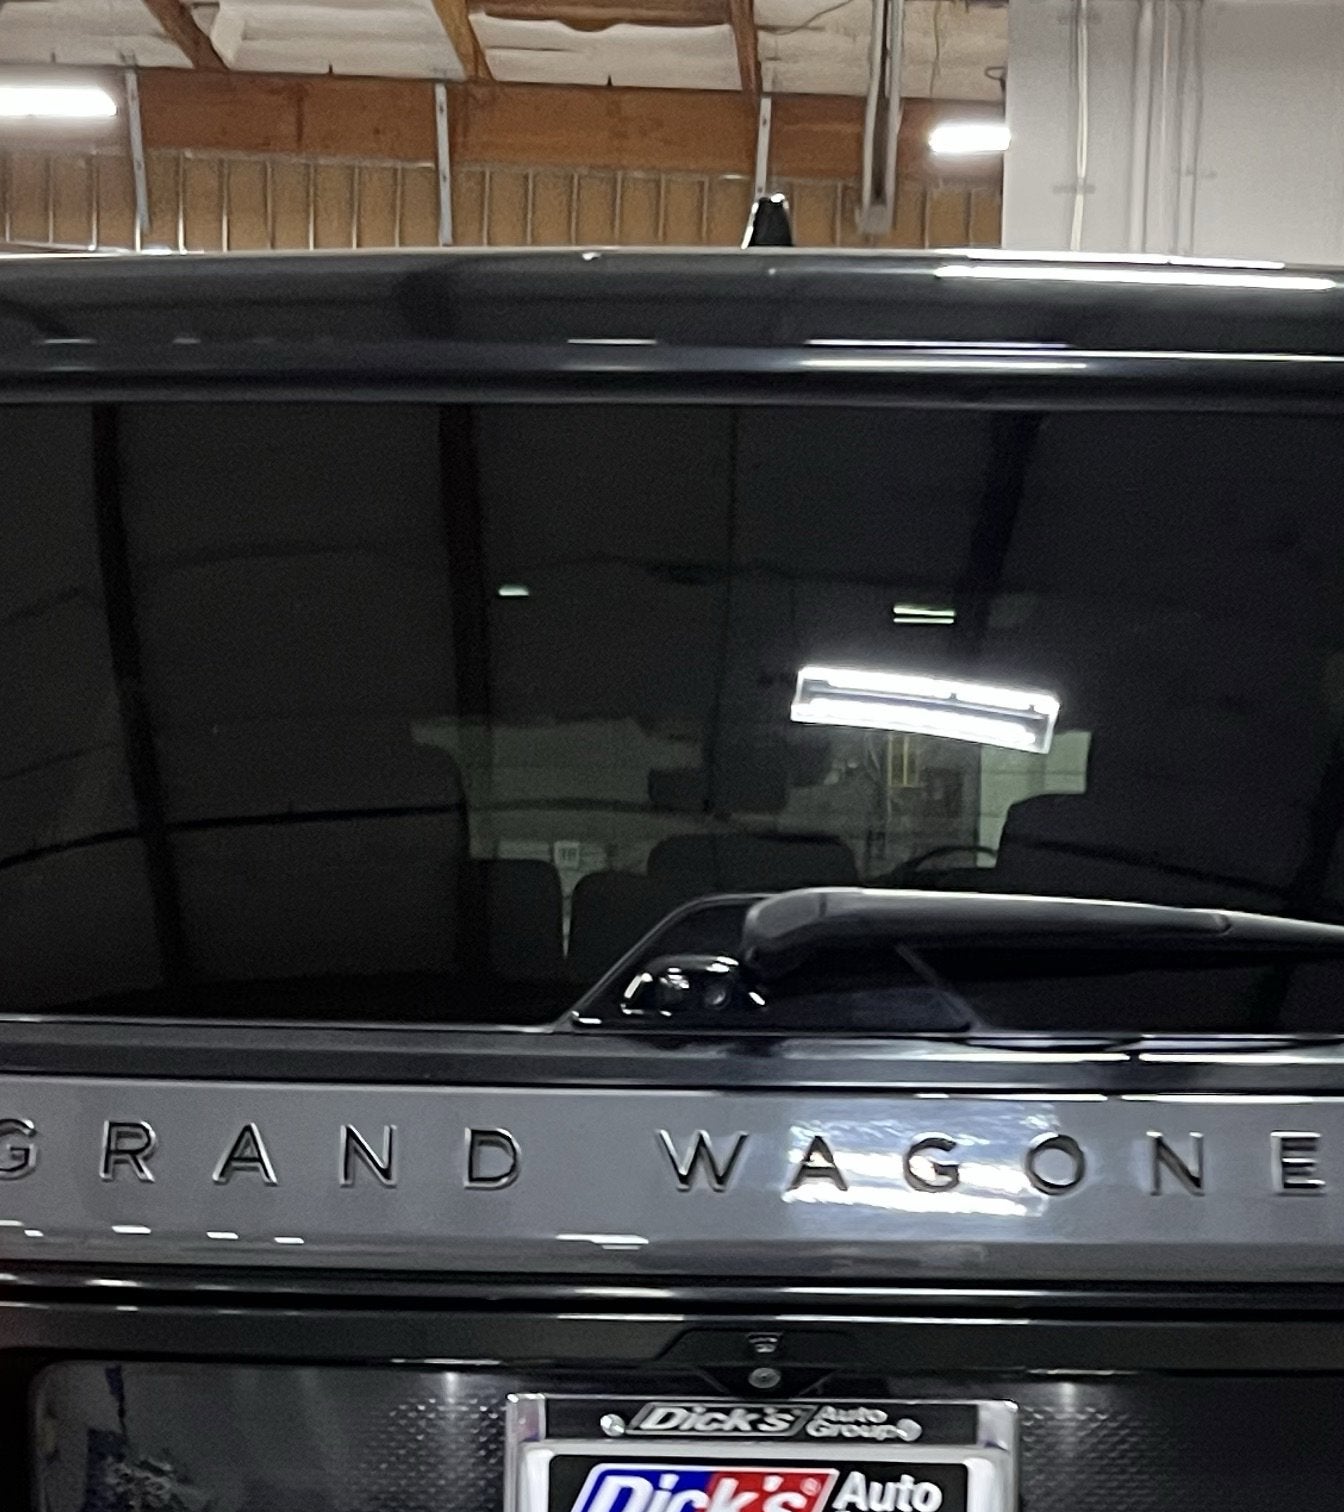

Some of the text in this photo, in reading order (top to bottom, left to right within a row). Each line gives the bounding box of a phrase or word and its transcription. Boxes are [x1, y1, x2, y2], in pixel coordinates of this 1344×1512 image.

[639, 1404, 888, 1433] Dick's Auto
[806, 1418, 900, 1441] Group
